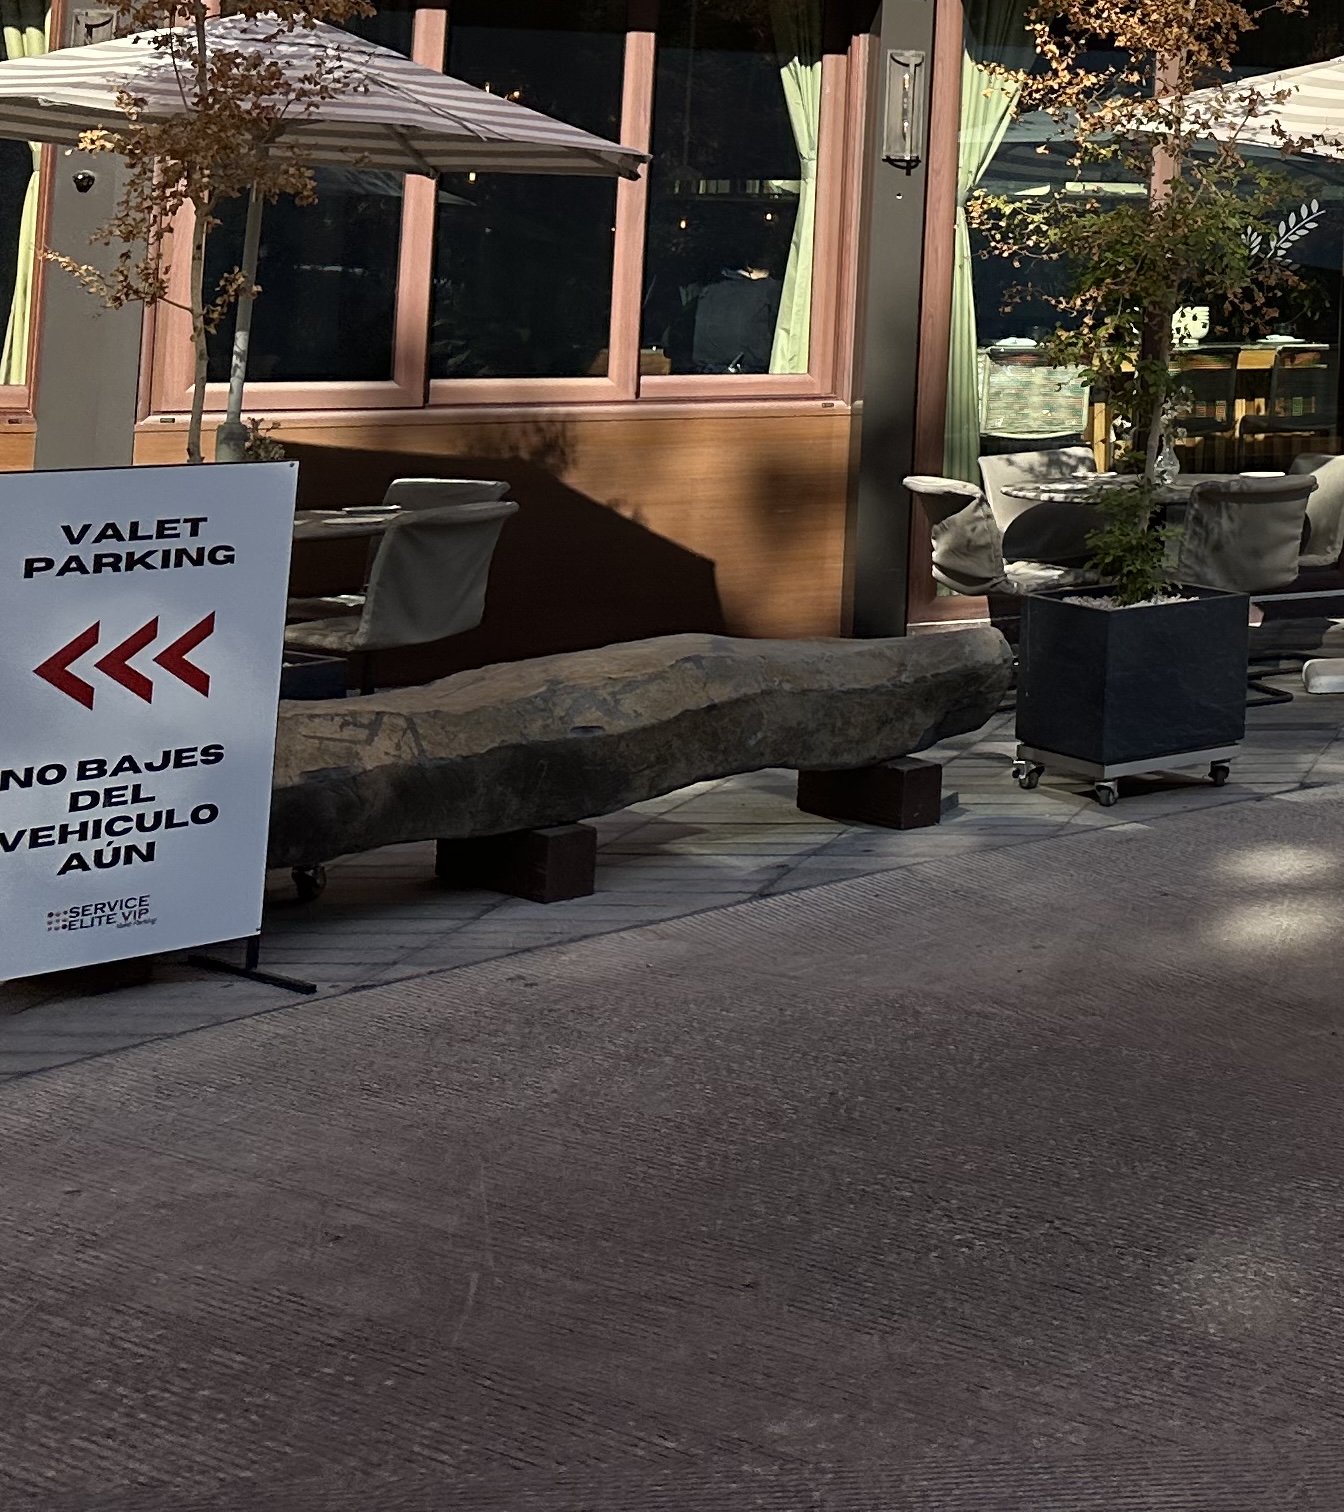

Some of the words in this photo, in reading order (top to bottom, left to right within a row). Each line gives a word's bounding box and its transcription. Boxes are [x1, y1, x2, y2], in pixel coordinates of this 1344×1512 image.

[60, 516, 208, 545] VALET
[23, 544, 236, 580] PARKING
[0, 763, 68, 792] NO
[76, 743, 225, 781] BAJES
[68, 783, 156, 813] DEL
[0, 803, 219, 853] VEHICULO
[56, 840, 156, 876] AÚN
[67, 913, 117, 931] ELITE
[121, 908, 149, 923] VIP
[68, 894, 151, 919] SERVICE
